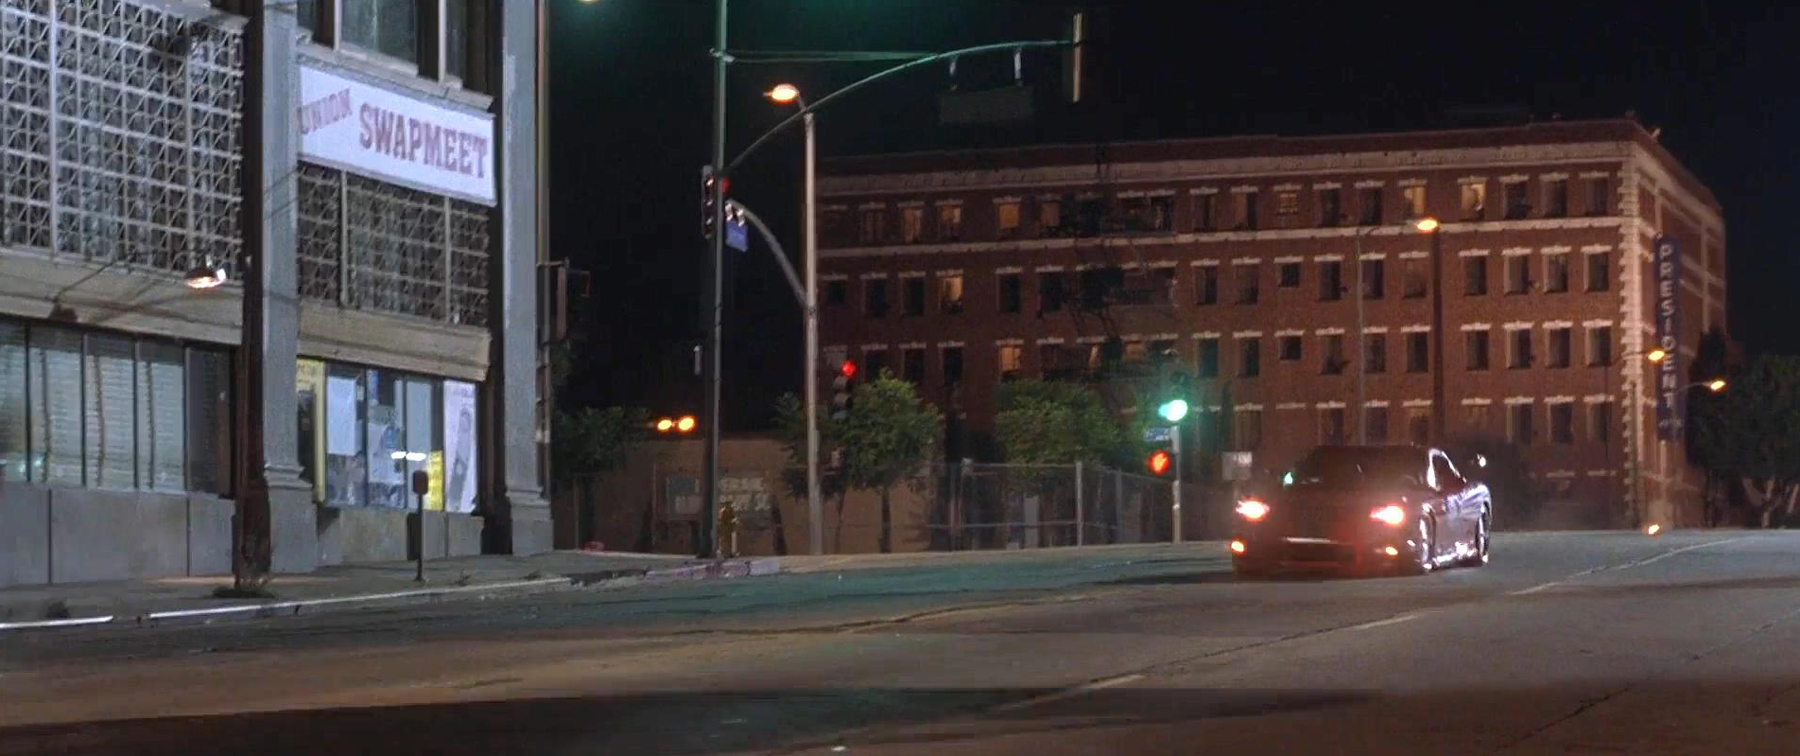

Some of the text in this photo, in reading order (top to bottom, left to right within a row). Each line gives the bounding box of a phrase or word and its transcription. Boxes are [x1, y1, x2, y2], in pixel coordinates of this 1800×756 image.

[298, 89, 489, 178] UNION SWAPMEET
[1659, 244, 1678, 408] PRESIDENT
